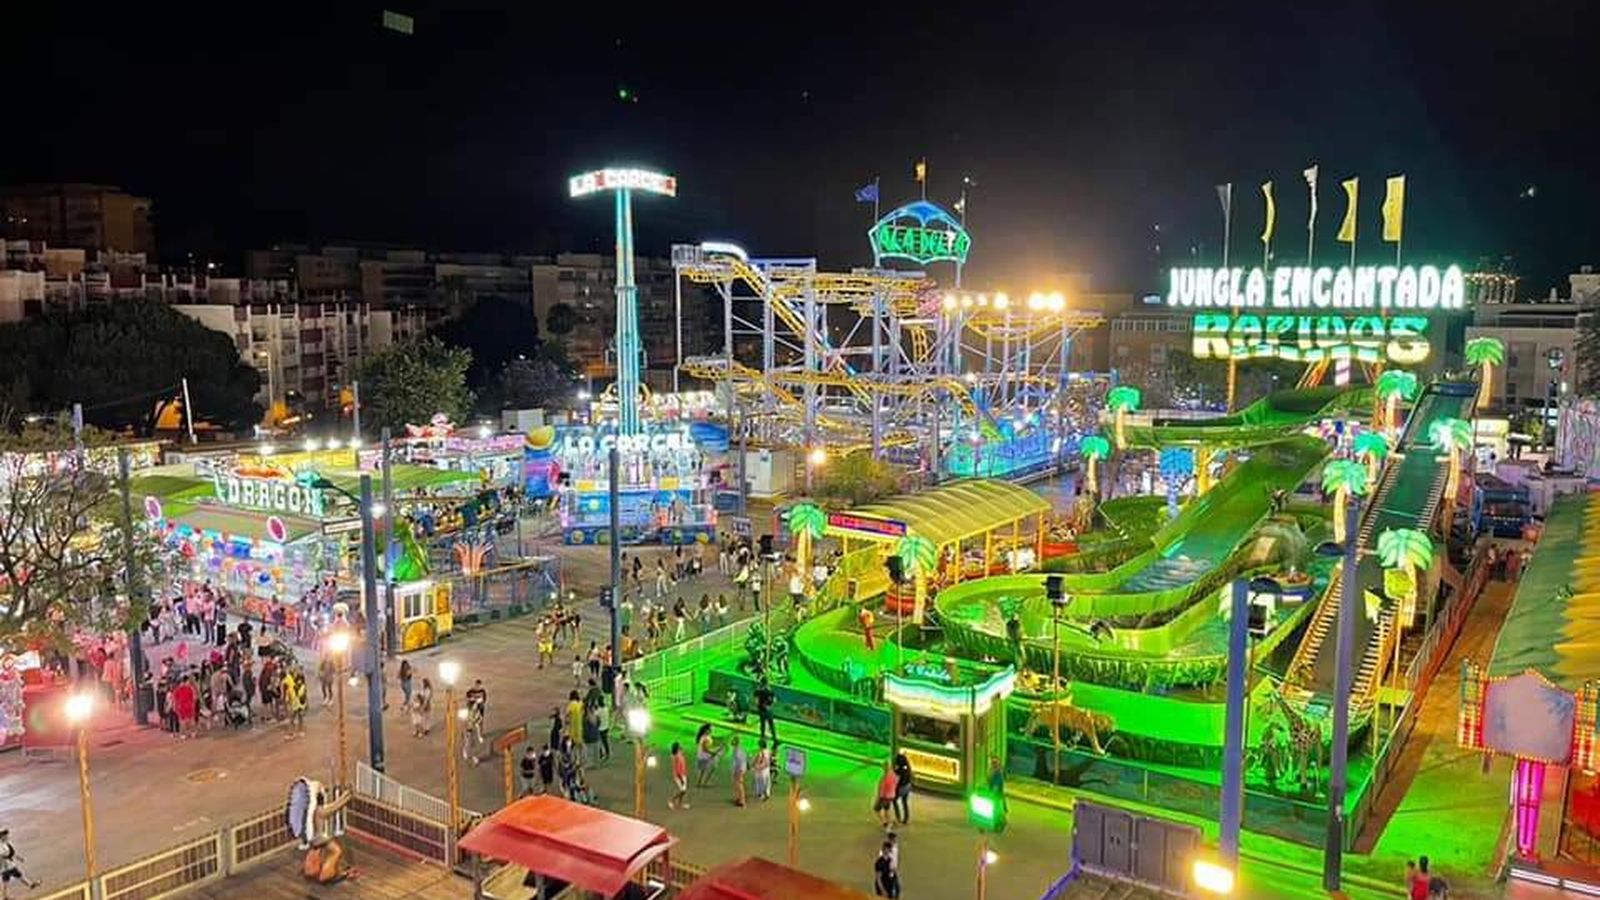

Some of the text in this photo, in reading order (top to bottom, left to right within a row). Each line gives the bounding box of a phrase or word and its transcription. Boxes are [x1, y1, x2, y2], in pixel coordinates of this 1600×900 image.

[1167, 265, 1465, 309] JUNGLA ENCANTADA
[228, 478, 324, 516] DRAGON
